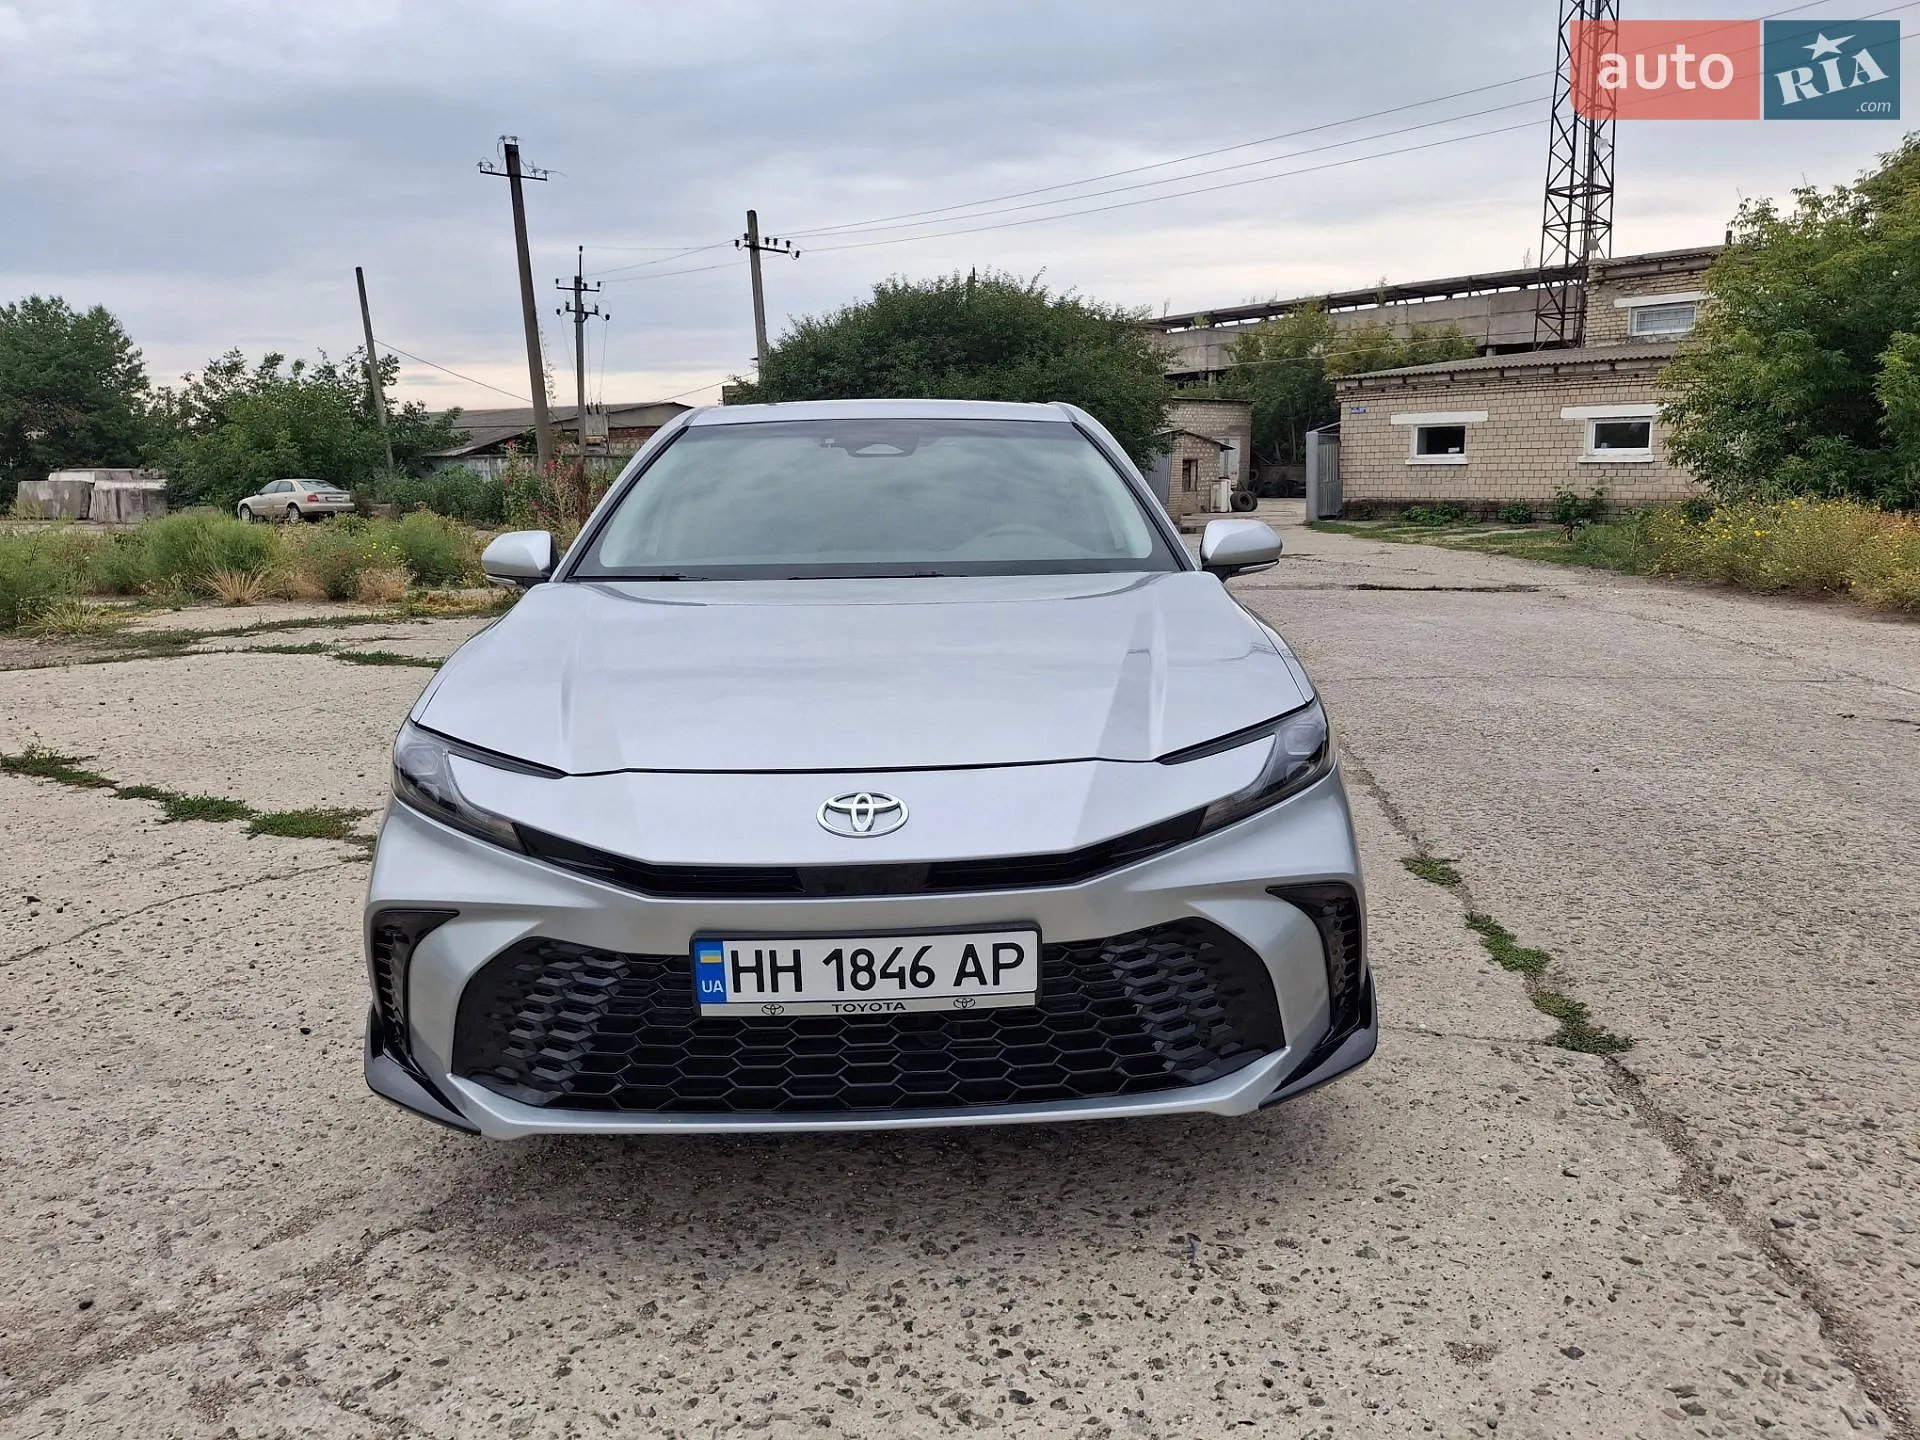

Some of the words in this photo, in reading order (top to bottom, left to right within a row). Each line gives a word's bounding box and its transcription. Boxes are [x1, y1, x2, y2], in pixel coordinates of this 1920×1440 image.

[731, 948, 804, 993] HH
[822, 945, 936, 992] 1846
[952, 942, 1026, 987] AP
[701, 979, 724, 993] UA
[831, 1002, 907, 1013] TOYOTA
